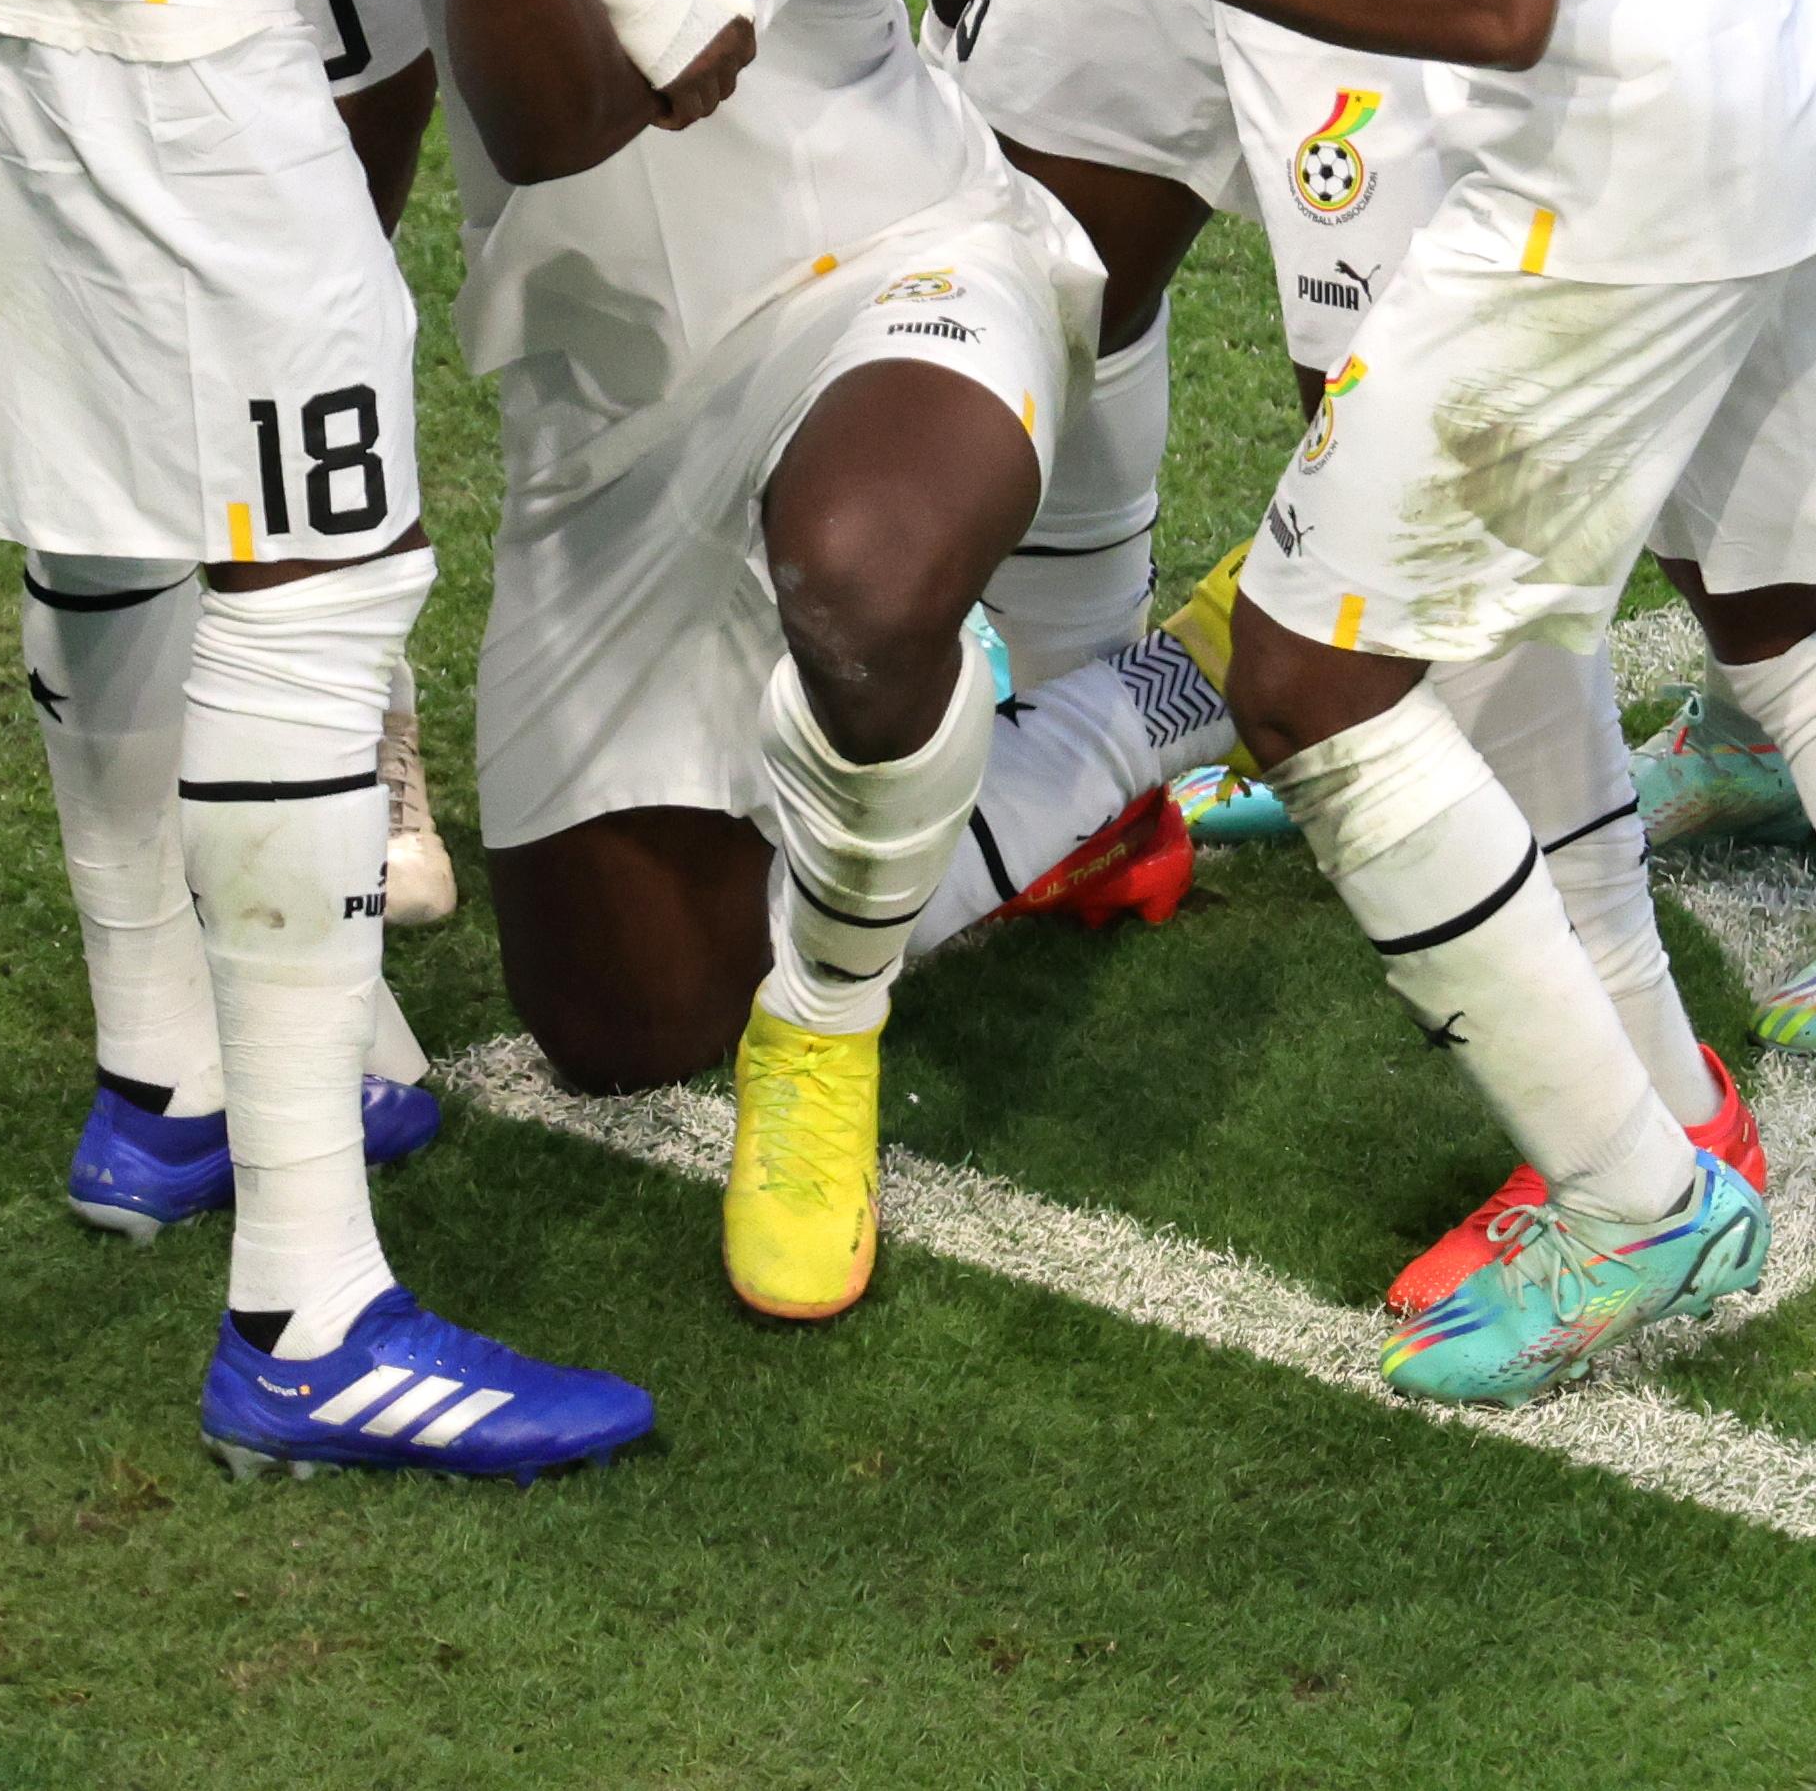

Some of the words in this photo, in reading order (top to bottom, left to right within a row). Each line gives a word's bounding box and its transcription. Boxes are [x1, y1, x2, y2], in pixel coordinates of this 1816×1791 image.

[1298, 274, 1360, 311] PUMA
[887, 320, 967, 343] PUMA
[249, 382, 389, 537] 18
